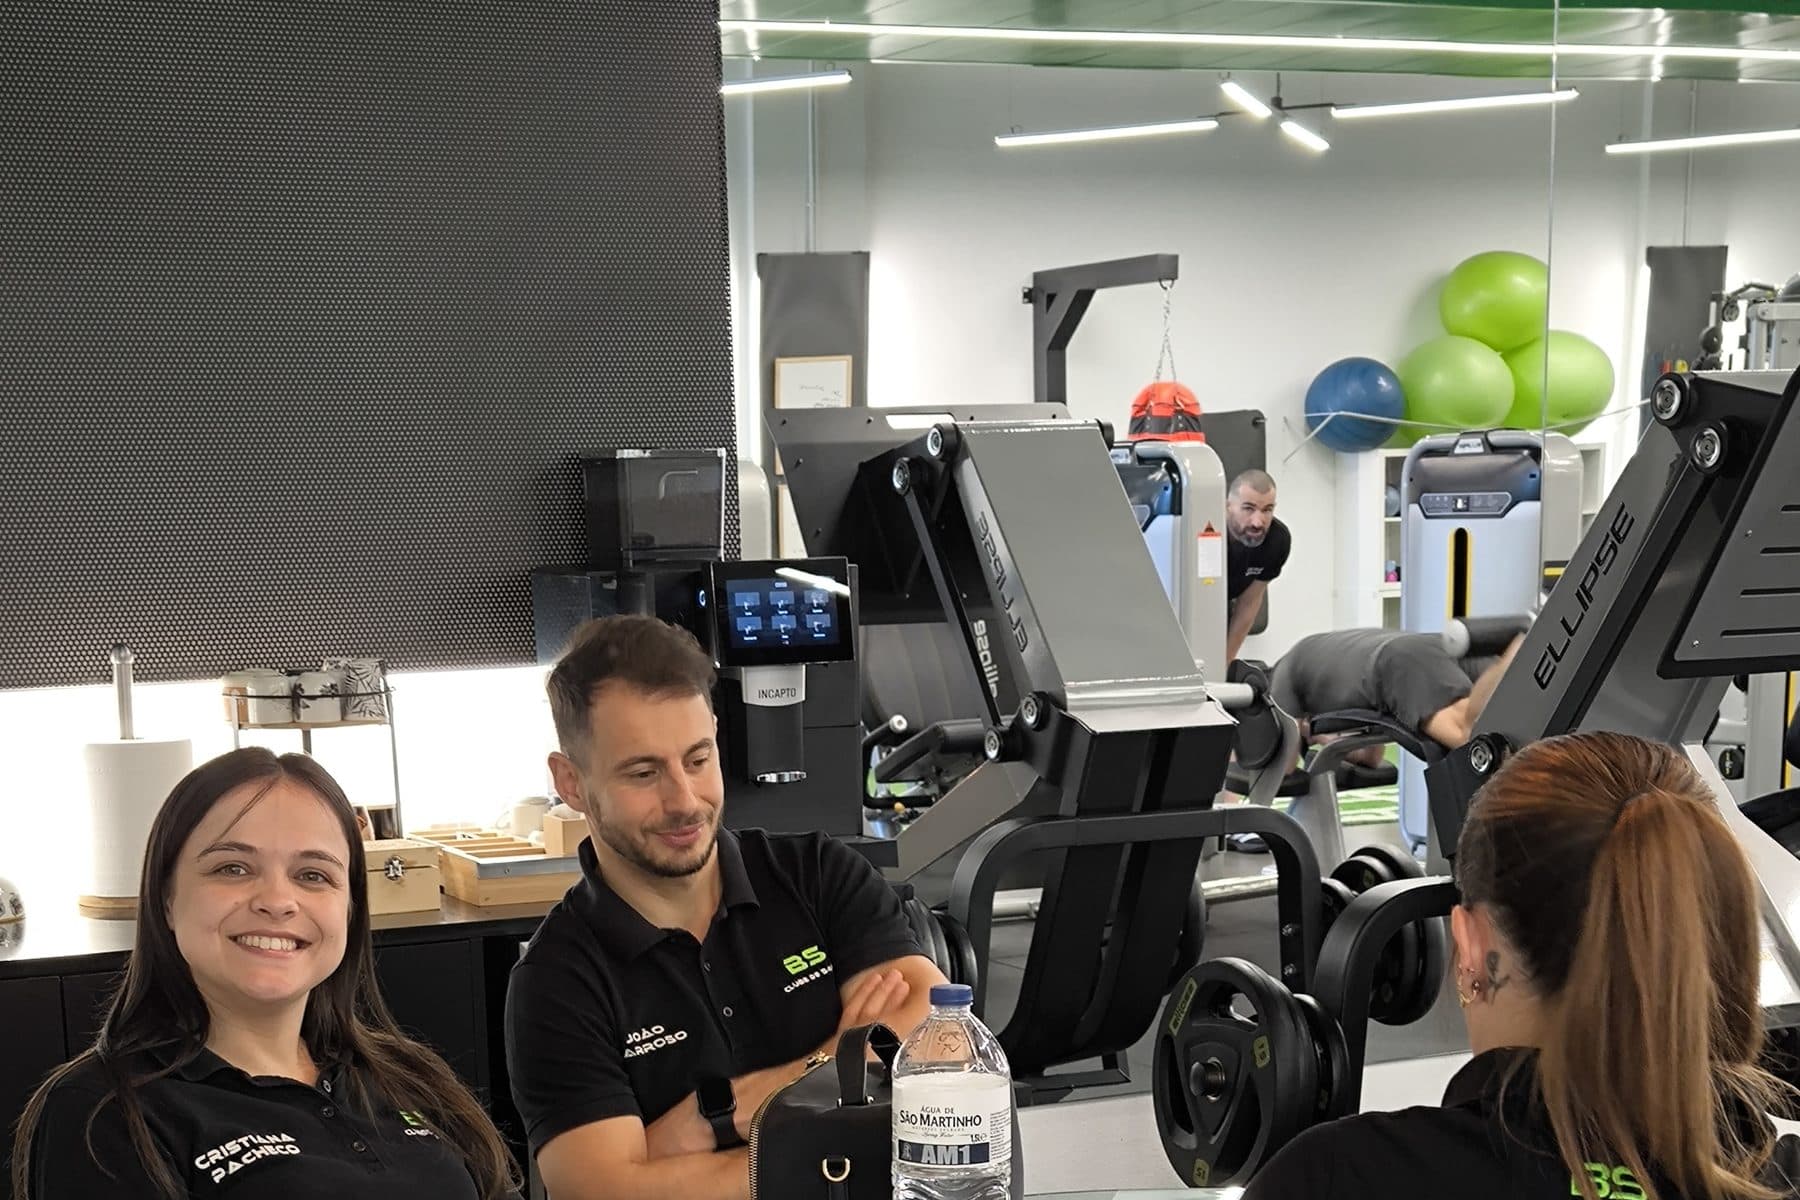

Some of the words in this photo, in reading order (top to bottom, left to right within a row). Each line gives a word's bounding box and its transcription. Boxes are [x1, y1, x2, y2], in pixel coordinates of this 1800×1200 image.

[1533, 502, 1635, 690] ELLIPSE
[758, 687, 797, 699] INCAPTO
[783, 945, 827, 975] BS
[623, 1030, 688, 1059] ARROSO
[919, 1112, 982, 1129] MARTINHO
[194, 1132, 297, 1170] CRISTIANA
[210, 1144, 301, 1184] PACHECO
[920, 1144, 971, 1165] AM1
